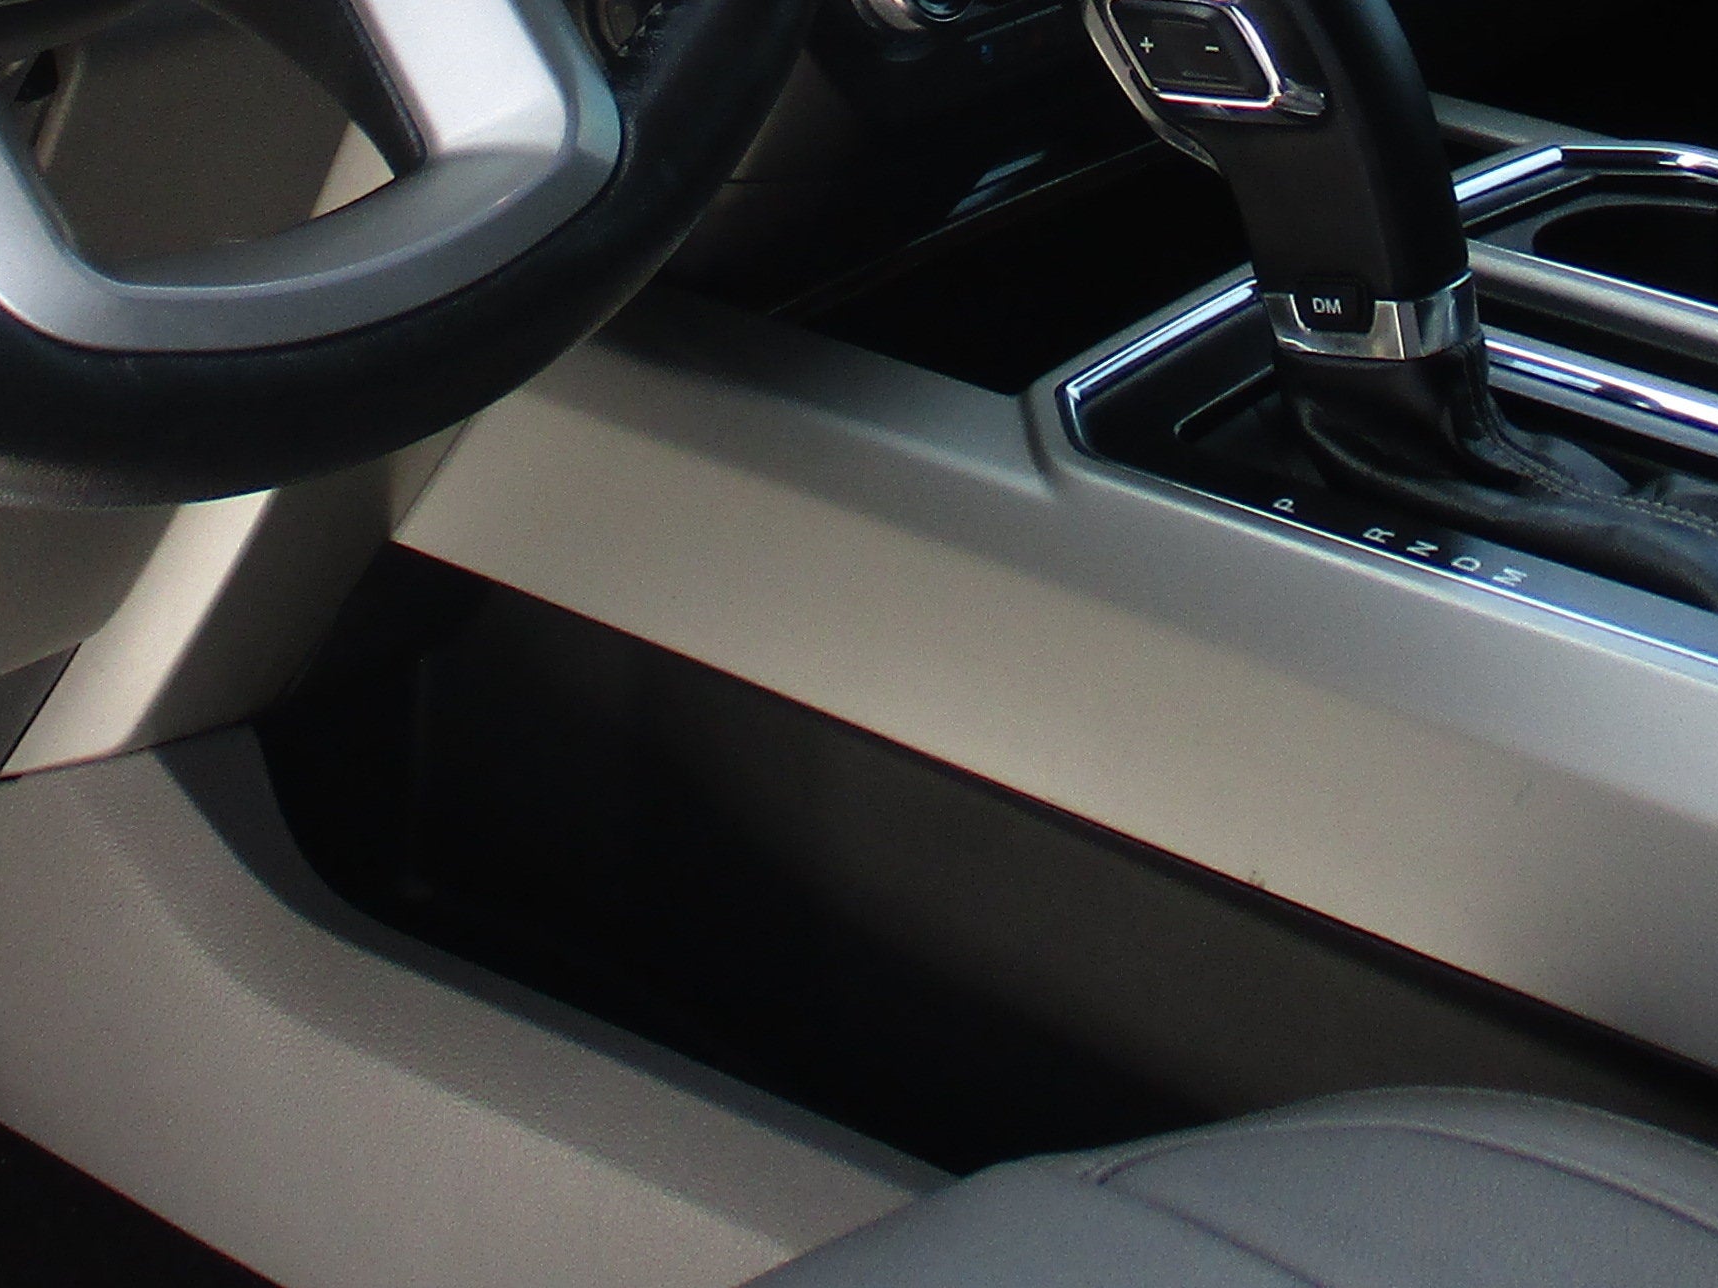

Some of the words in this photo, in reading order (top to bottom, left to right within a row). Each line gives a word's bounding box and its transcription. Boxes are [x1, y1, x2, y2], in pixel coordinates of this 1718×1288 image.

[1311, 296, 1342, 315] DM
[1271, 496, 1296, 514] P
[1361, 526, 1397, 545] R
[1405, 539, 1440, 558] N
[1450, 554, 1482, 573] D
[1492, 566, 1528, 588] M
